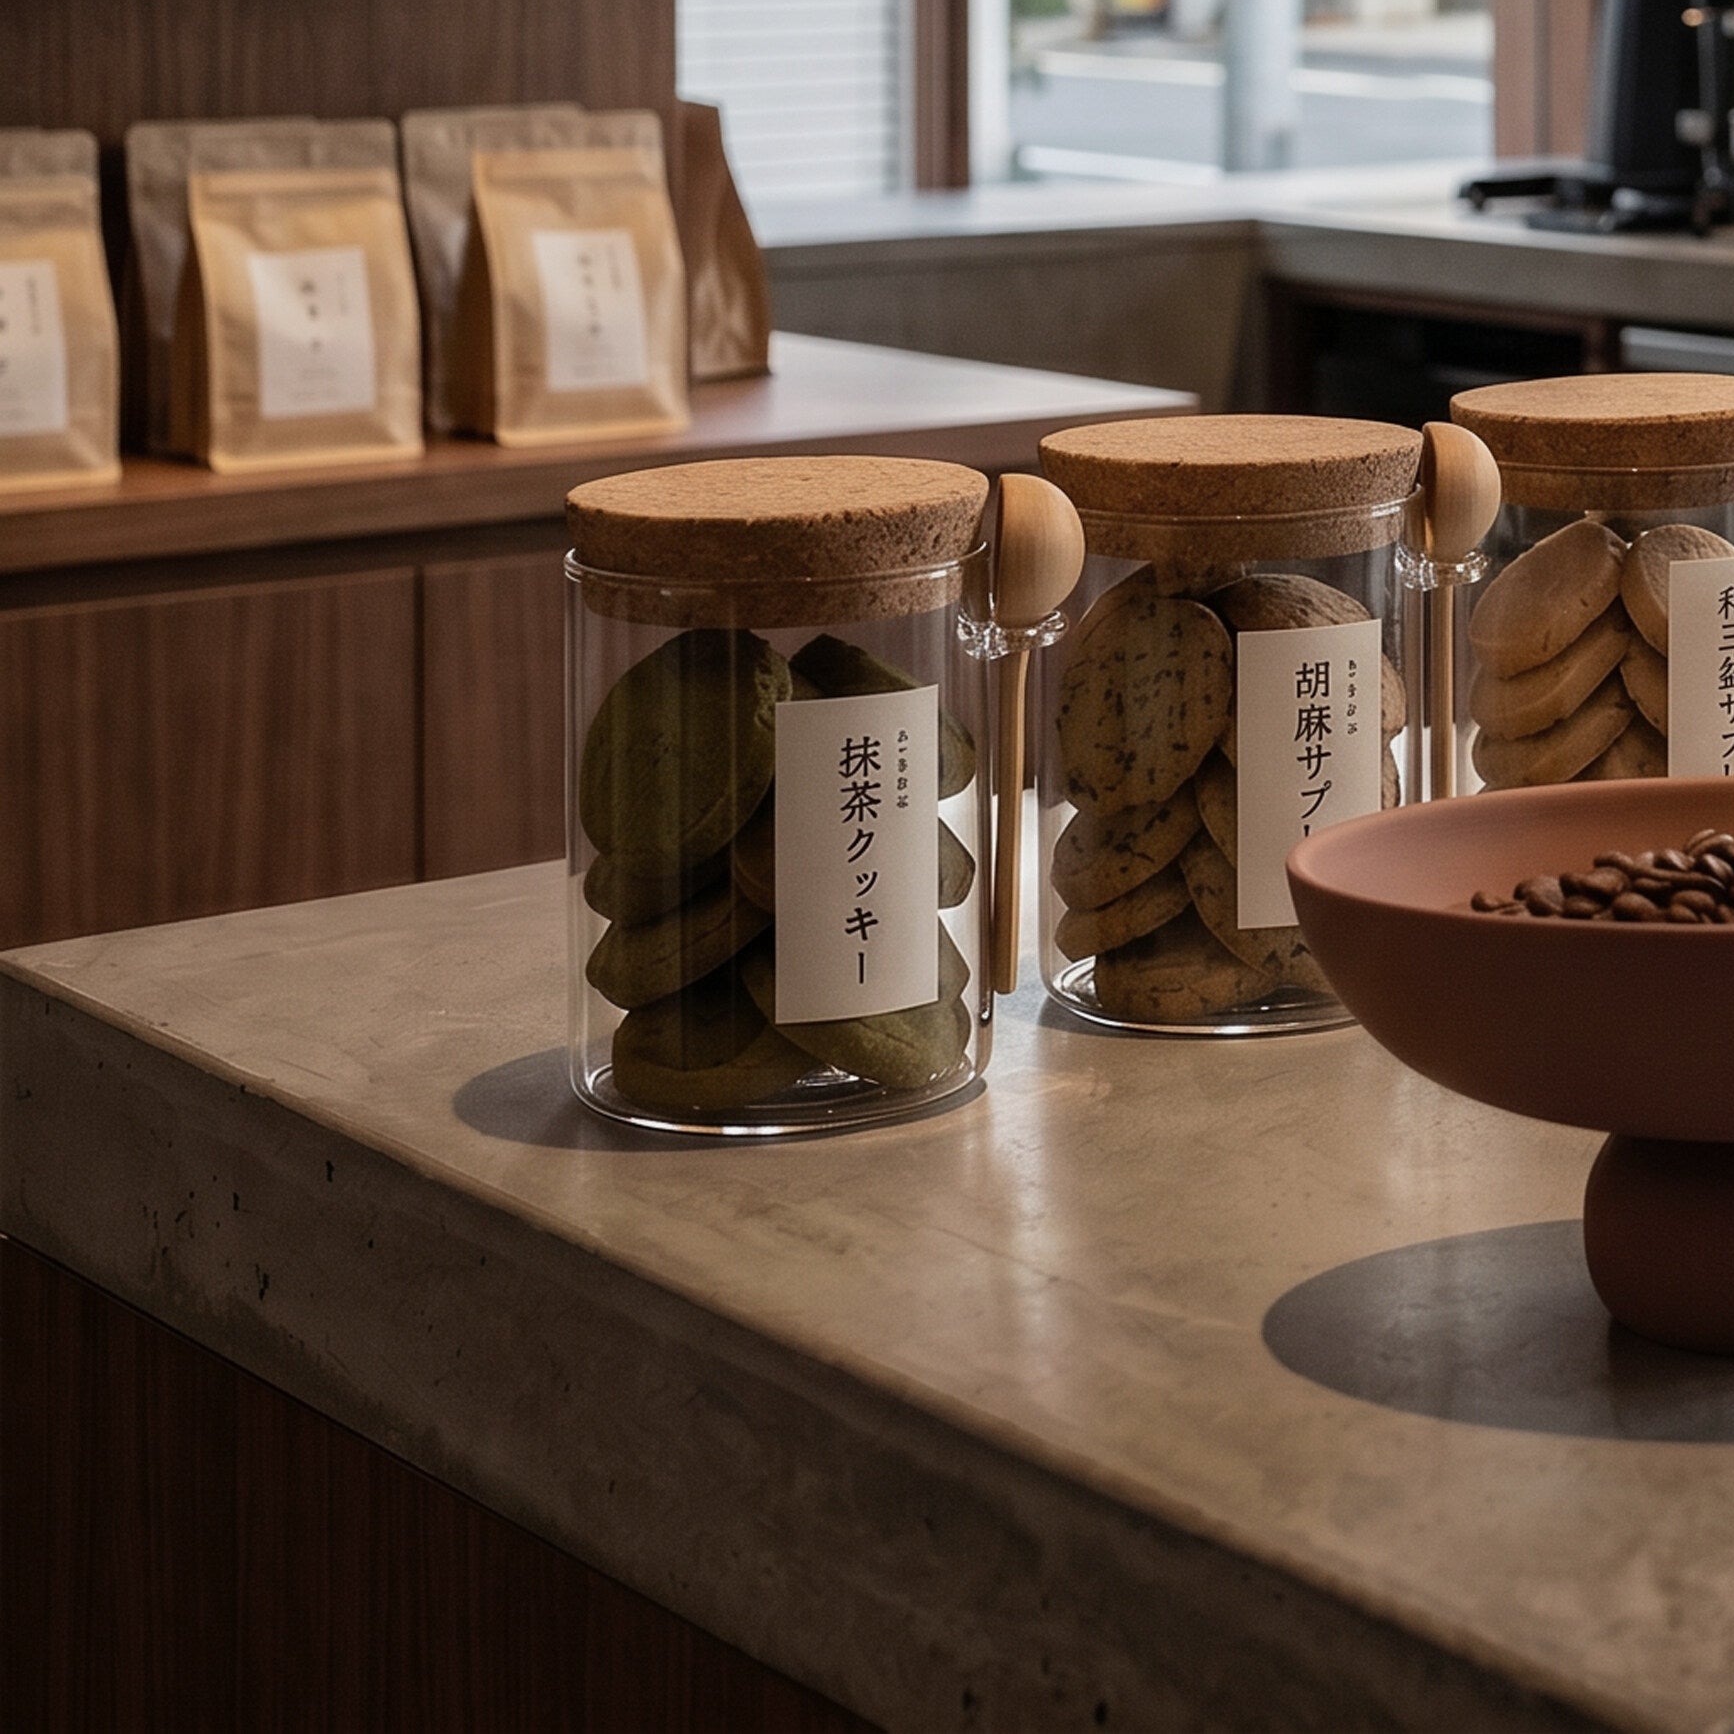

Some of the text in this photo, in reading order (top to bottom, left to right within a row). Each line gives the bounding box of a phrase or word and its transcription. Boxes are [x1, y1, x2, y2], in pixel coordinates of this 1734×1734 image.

[1293, 660, 1333, 839] 胡麻サプ
[838, 735, 882, 985] 抹茶クッキー
